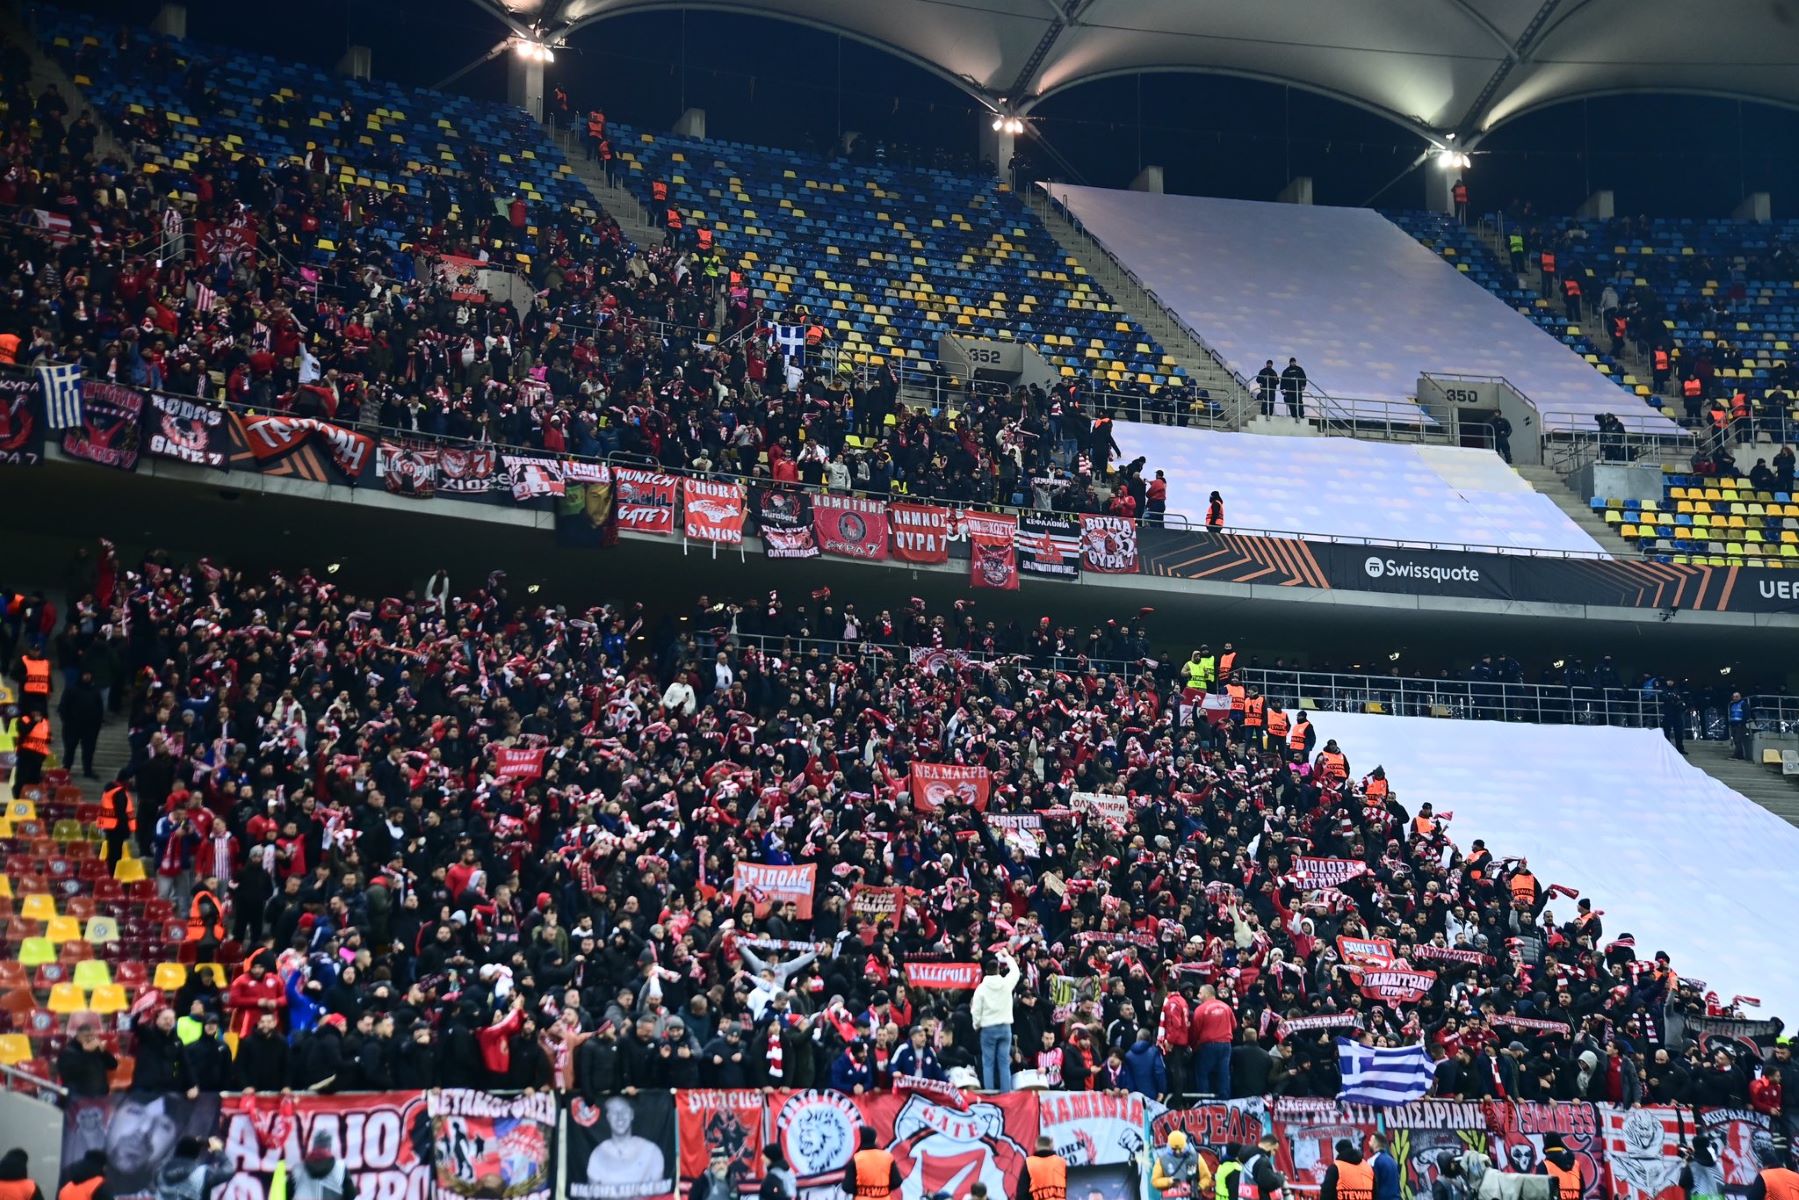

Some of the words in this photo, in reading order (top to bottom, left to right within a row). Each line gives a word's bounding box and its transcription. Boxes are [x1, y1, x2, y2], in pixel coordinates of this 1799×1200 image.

[969, 348, 1001, 364] 352
[1446, 388, 1478, 403] 350
[150, 434, 205, 463] GATE
[207, 452, 223, 465] 7
[616, 468, 675, 488] MUNICH
[685, 478, 739, 499] CHORA
[813, 494, 885, 514] ΚΟΜΟΤΗΝΗ
[617, 505, 659, 526] GATE
[660, 507, 670, 524] 7
[894, 509, 947, 528] ΛΗΜΝΟΣ
[687, 523, 742, 542] SAMOS
[1085, 517, 1133, 535] ΒΟΥΛΑ
[866, 543, 879, 558] 7
[896, 531, 937, 551] ΘΥΡΑ
[939, 535, 947, 551] 7
[768, 546, 819, 558] ΟΛΥΜΠΙΑΚΟΣ
[1089, 550, 1125, 569] ΘΥΡΑ
[1386, 559, 1480, 583] Swissquote
[914, 764, 940, 778] ΝΕΑ
[941, 766, 988, 779] ΜΑΚΡΗ
[987, 815, 1040, 829] PERISTERI
[739, 865, 811, 888] ΤΡΙΠΟΛΗ
[1342, 940, 1389, 957] SOUFLI
[921, 1107, 979, 1139] GATE
[1383, 1101, 1487, 1129] ΚΑΙΣΑΡΙΑΝΗ
[1152, 1104, 1262, 1149] ΚΥΨΕΛΗ
[1057, 1139, 1086, 1157] ORN
